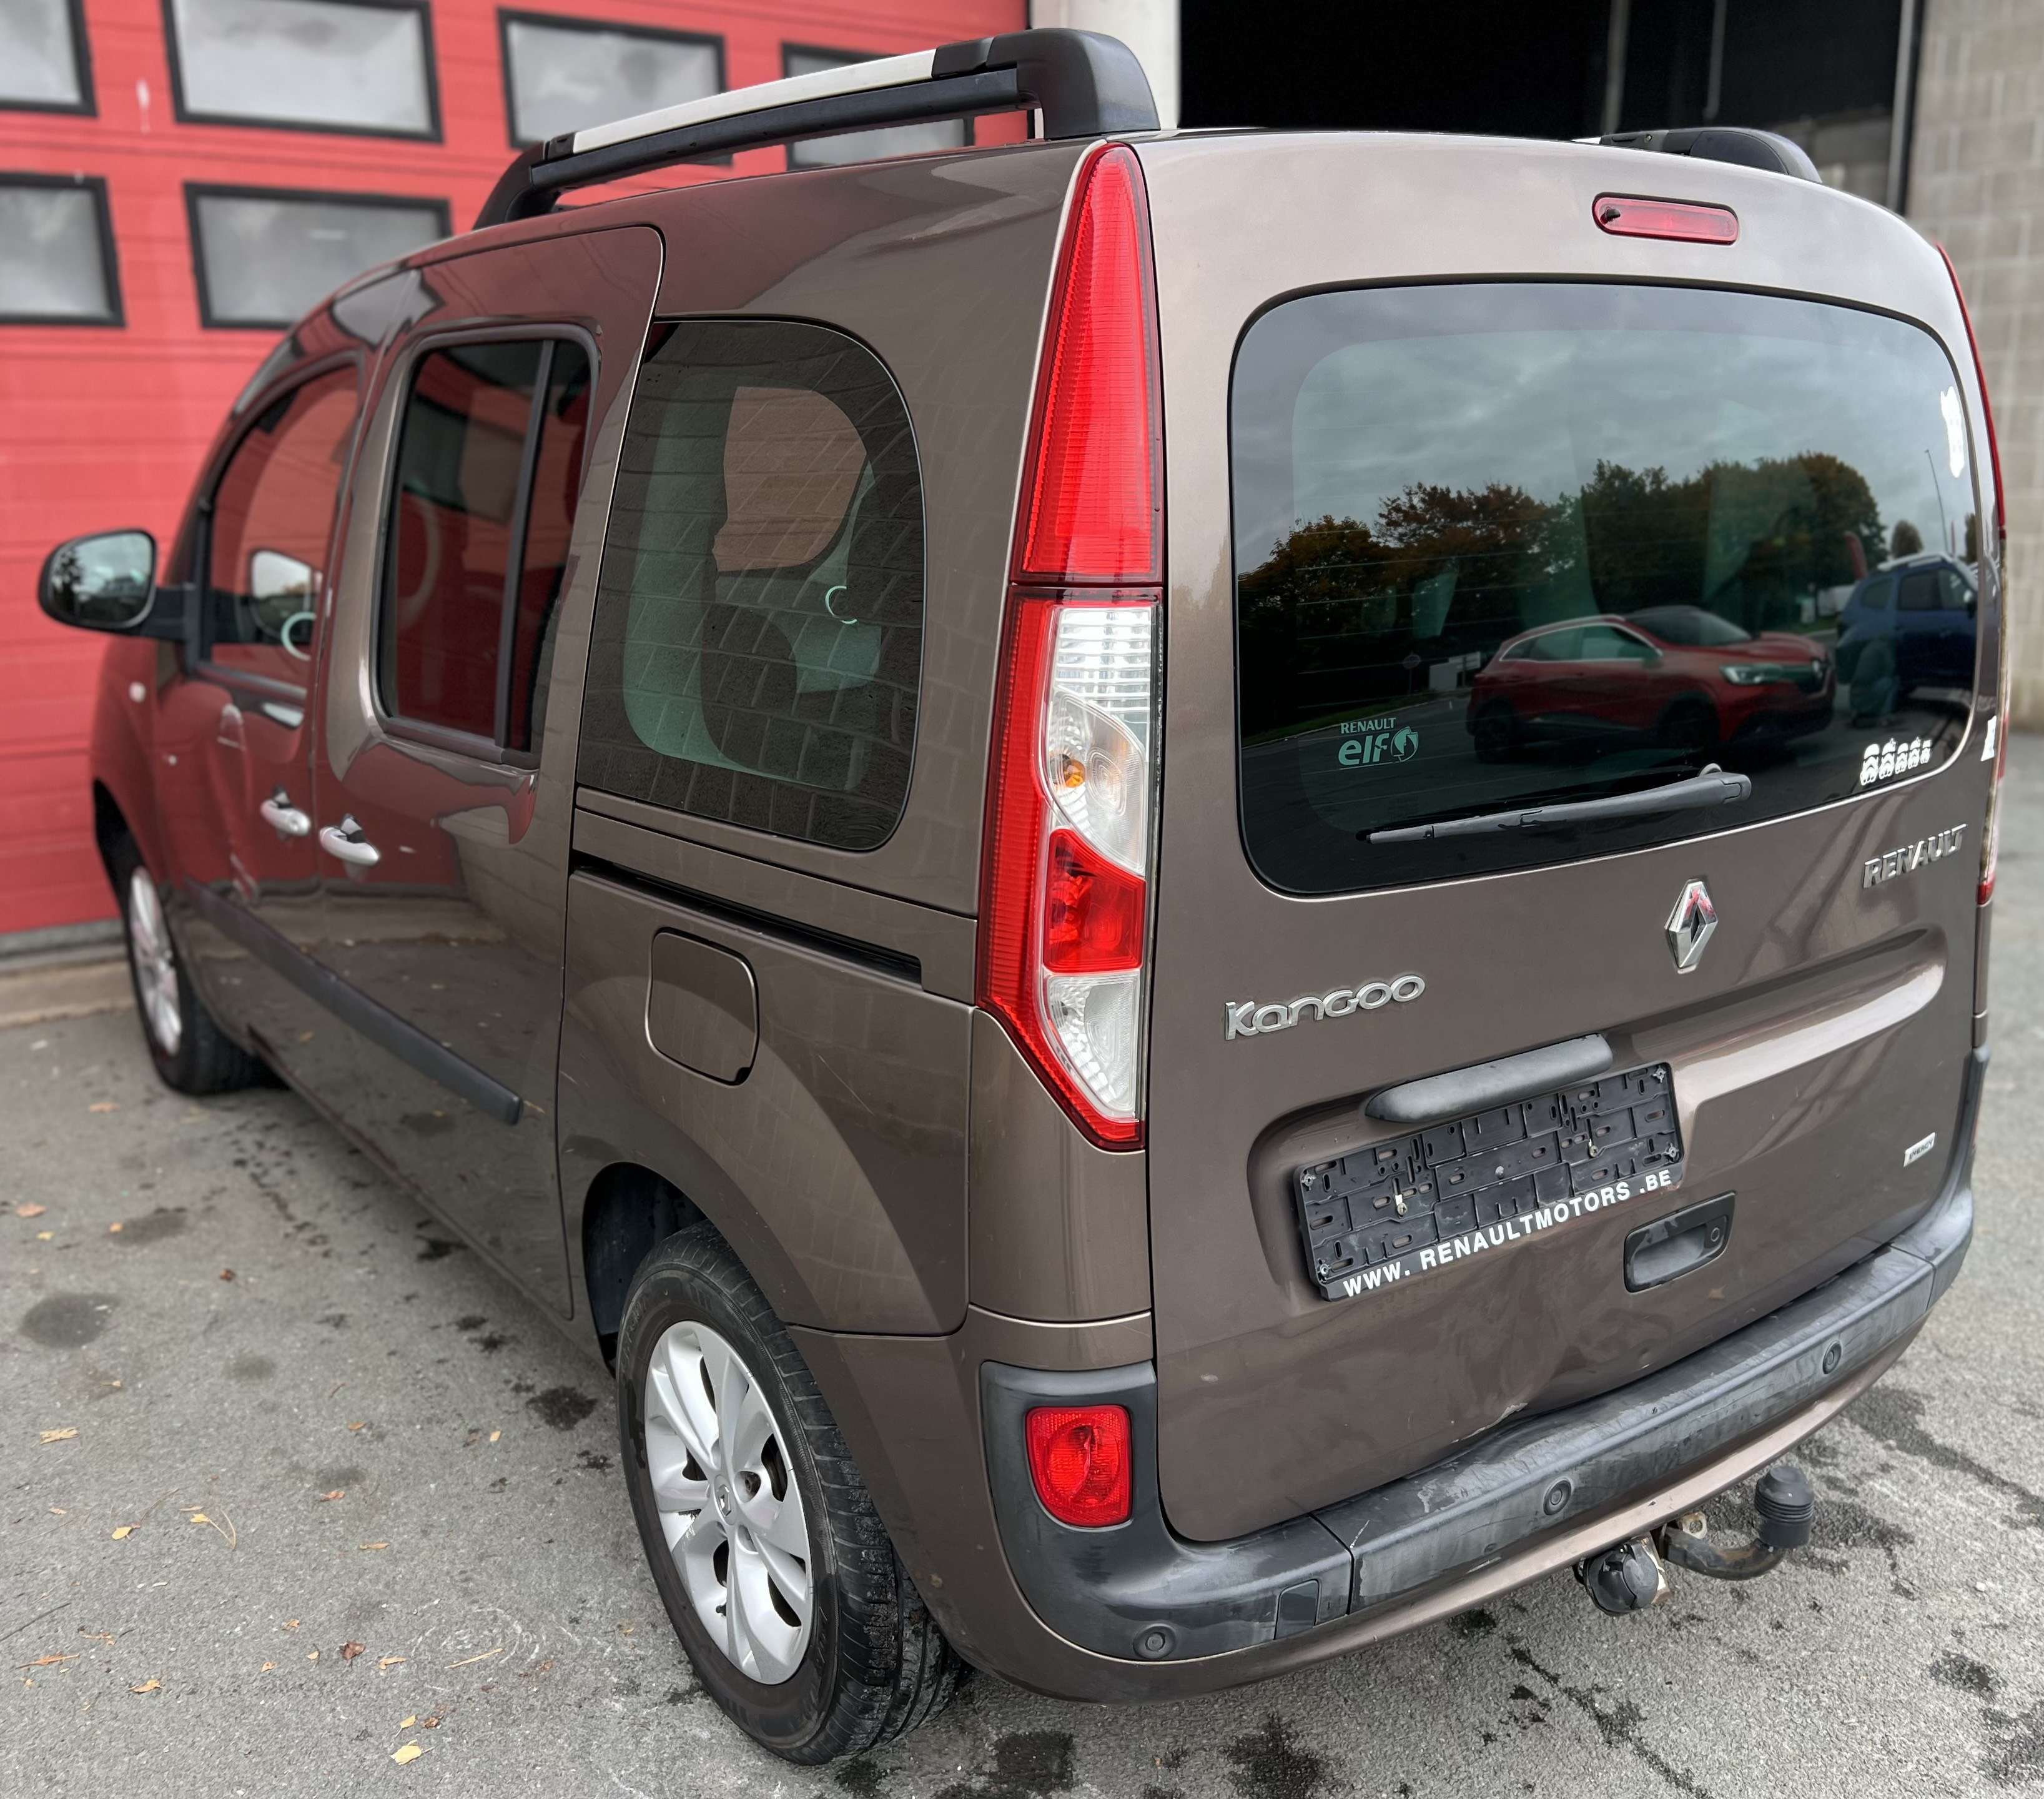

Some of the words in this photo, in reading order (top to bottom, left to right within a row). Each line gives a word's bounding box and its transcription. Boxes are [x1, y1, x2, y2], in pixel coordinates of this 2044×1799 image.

[1338, 733, 1390, 766] elf
[1340, 717, 1396, 735] RENAULT
[1863, 823, 1968, 888] RENAULT
[1343, 1261, 1411, 1297] WWW.
[1419, 1181, 1631, 1271] RENAULTMOTORS
